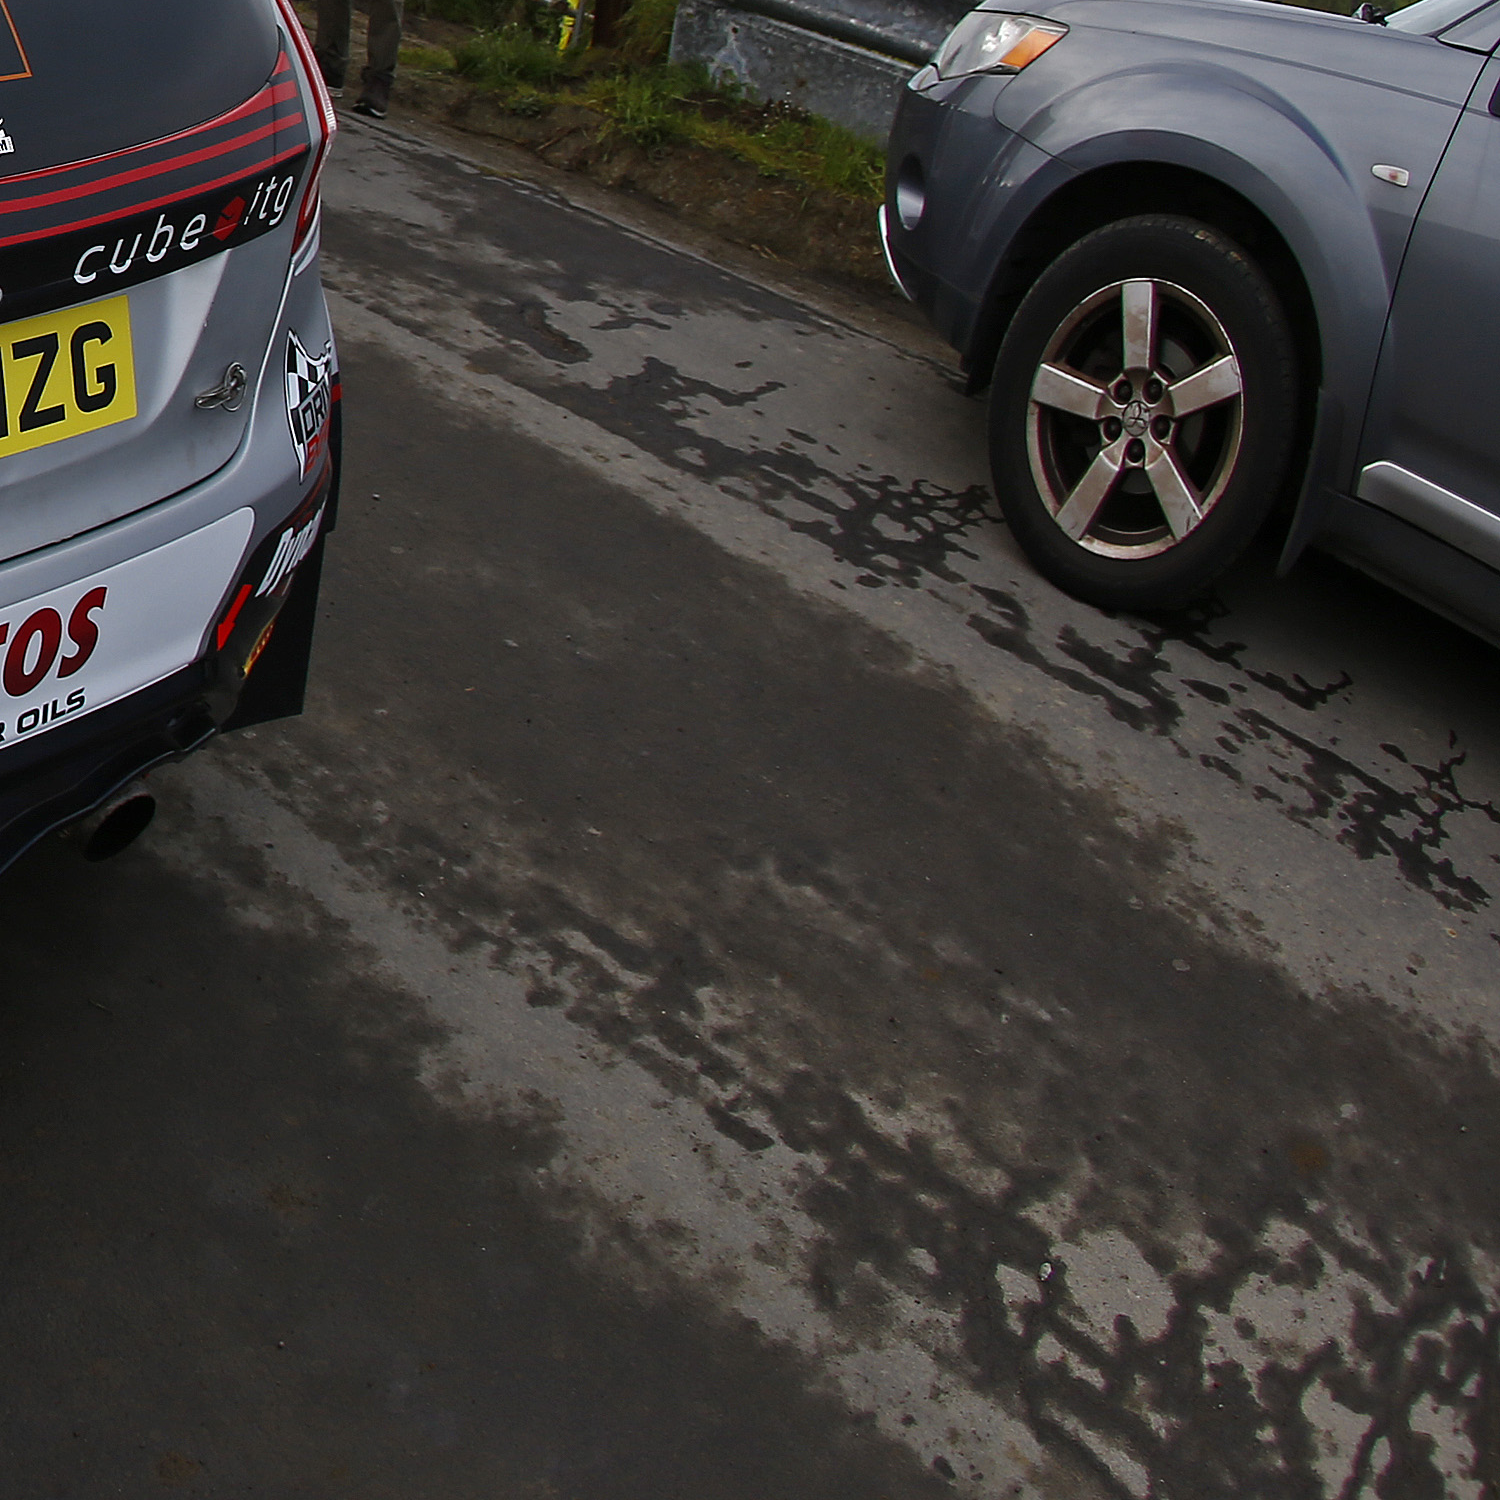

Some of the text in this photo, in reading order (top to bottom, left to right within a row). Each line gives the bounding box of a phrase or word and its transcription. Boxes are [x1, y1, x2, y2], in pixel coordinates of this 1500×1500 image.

[73, 176, 294, 284] cube itg
[15, 688, 87, 734] OILS
